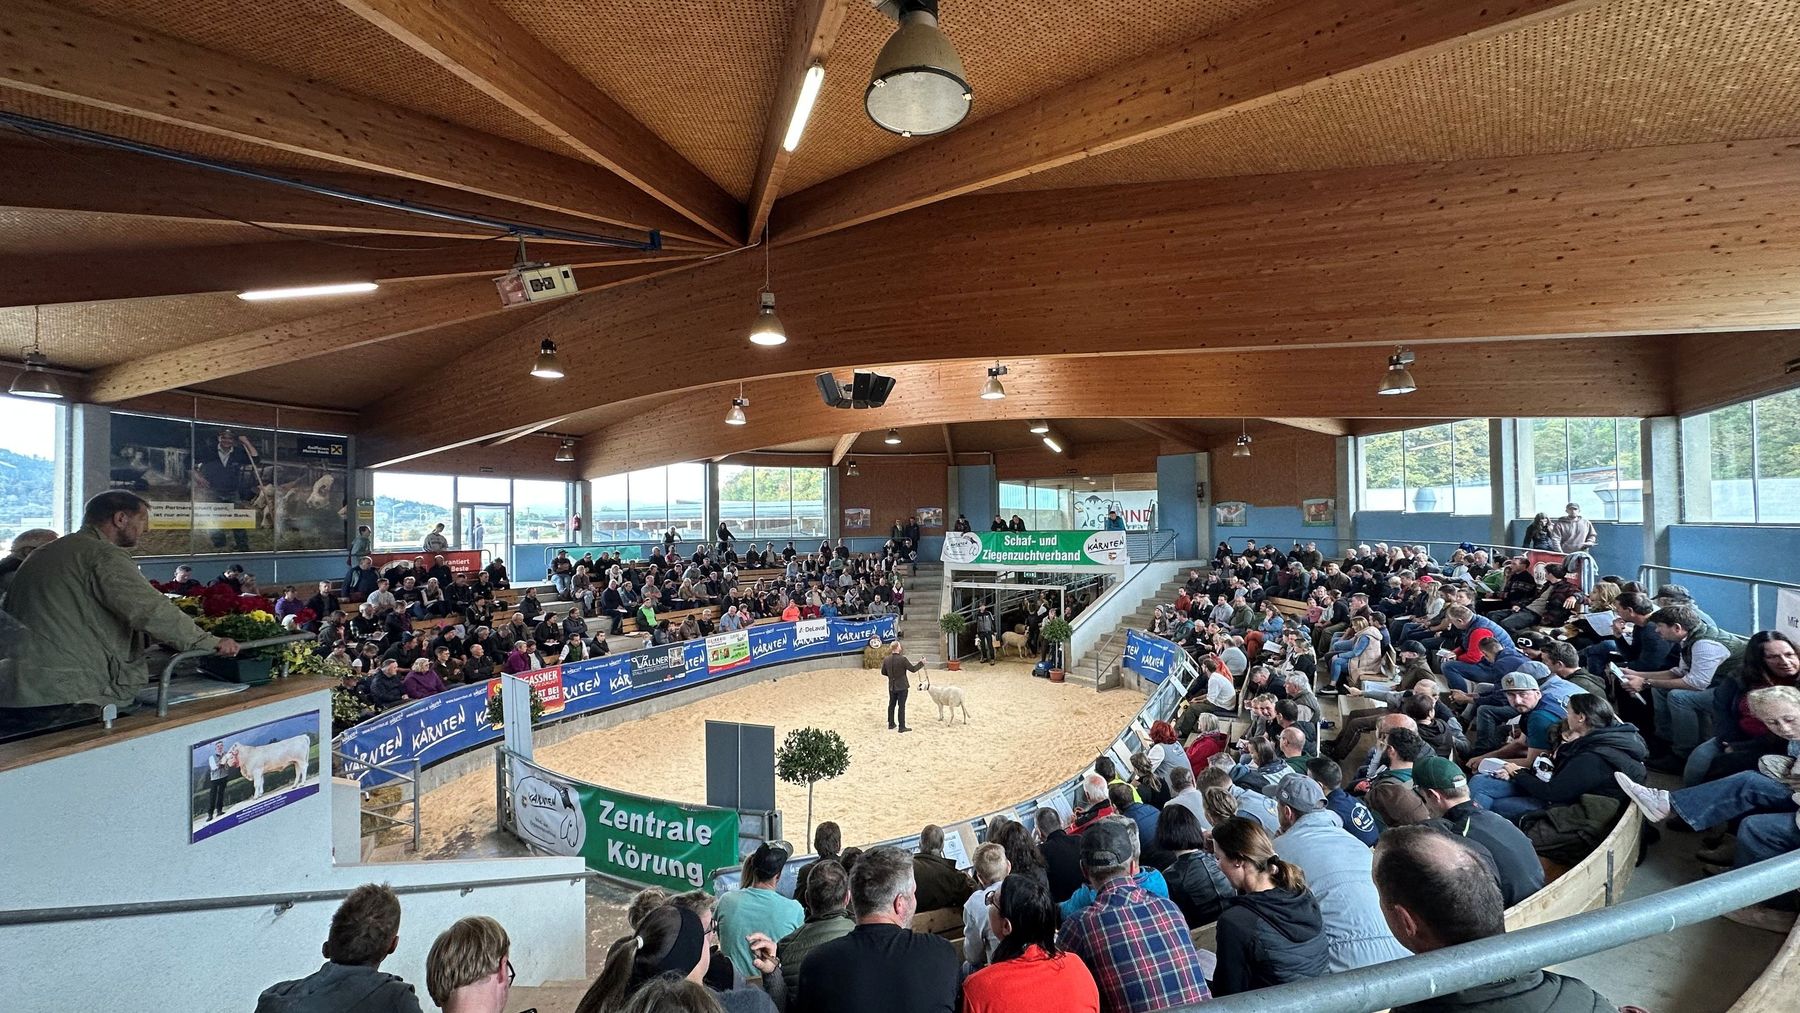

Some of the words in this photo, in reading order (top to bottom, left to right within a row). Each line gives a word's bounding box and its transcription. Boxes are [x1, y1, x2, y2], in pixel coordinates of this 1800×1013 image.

[1004, 534, 1036, 547] Schaf-
[1039, 535, 1057, 546] und
[981, 549, 1081, 562] Ziegenzuchtverband
[805, 625, 825, 634] DeLaval
[547, 686, 560, 696] BEI
[599, 800, 713, 846] Zentrale
[606, 838, 704, 887] Körung
